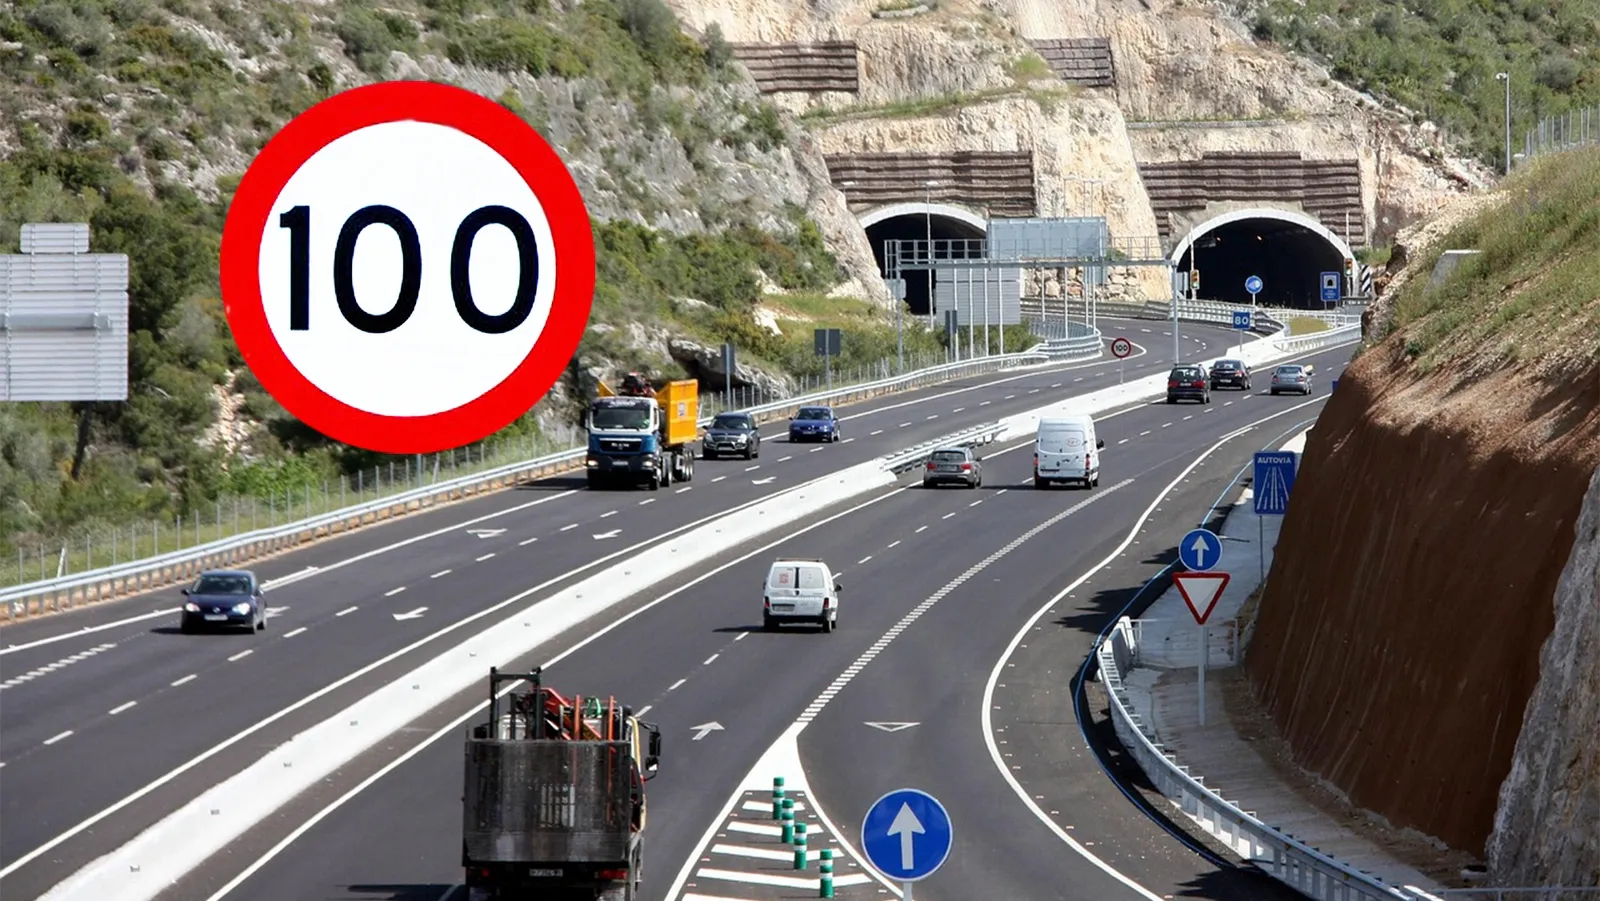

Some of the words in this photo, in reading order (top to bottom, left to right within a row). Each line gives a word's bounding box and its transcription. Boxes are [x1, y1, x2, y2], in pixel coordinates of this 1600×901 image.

[1234, 315, 1249, 325] 80
[1115, 344, 1129, 352] 100
[1257, 456, 1292, 464] AUTOVIA
